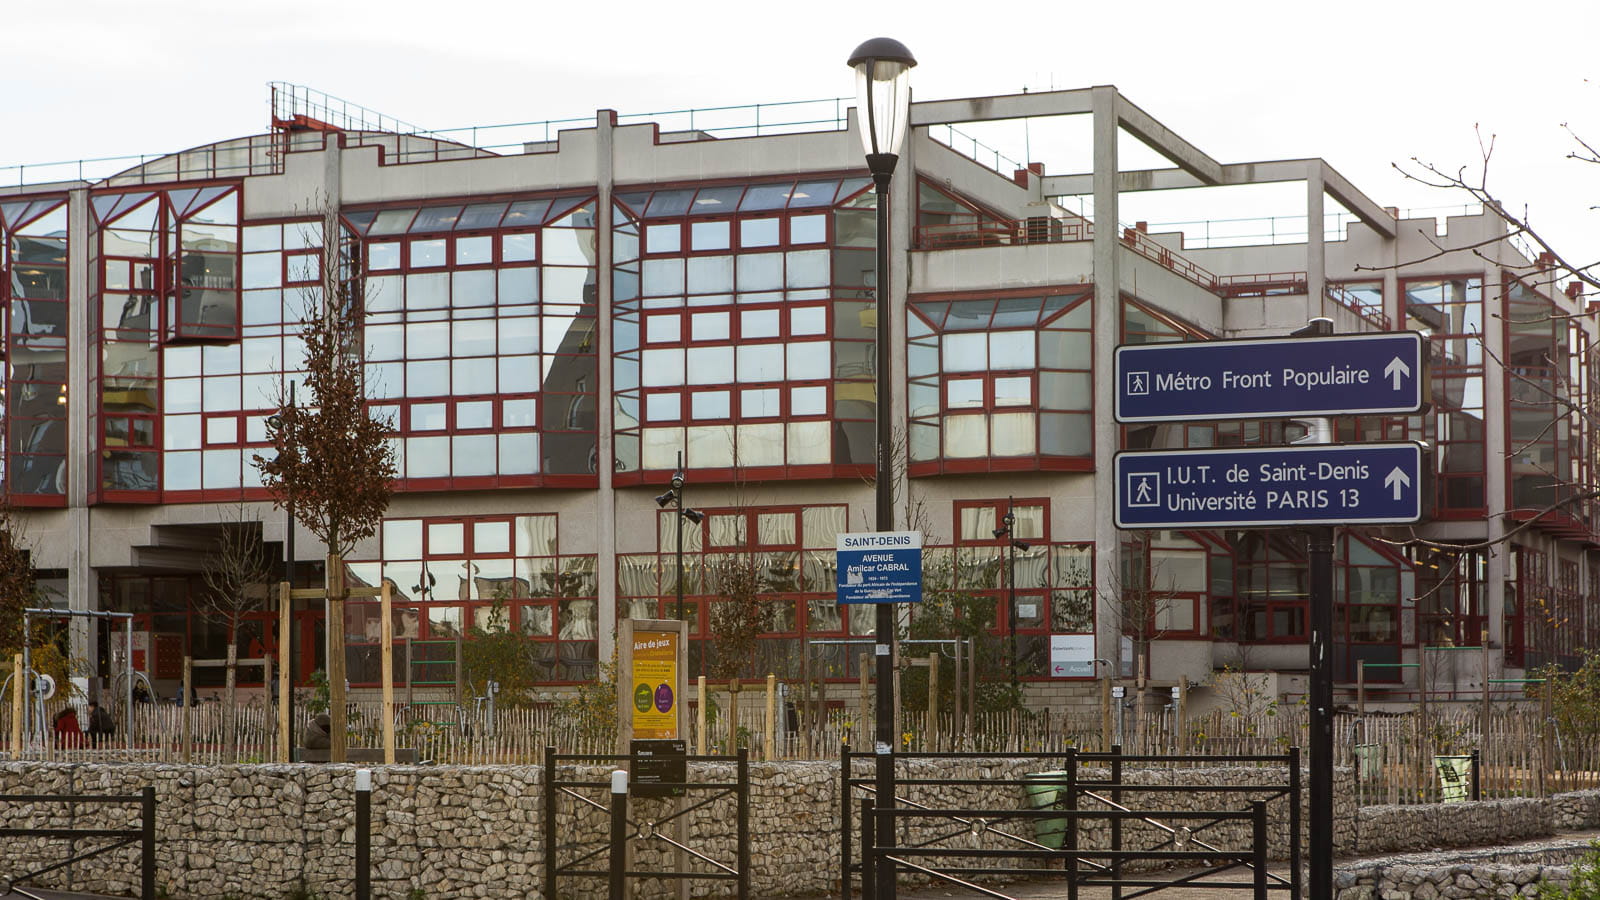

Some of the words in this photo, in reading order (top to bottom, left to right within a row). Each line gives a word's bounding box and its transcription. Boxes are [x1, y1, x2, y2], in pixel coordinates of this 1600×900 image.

[1156, 371, 1211, 391] Métro
[1223, 369, 1271, 388] Front
[1283, 365, 1370, 391] Populaire
[1167, 466, 1216, 484] I.U.T.
[1226, 464, 1250, 483] de
[1260, 461, 1370, 482] Saint-Denis
[1167, 490, 1256, 511] Université
[1266, 490, 1329, 509] PARIS
[1339, 489, 1360, 508] 13
[845, 536, 911, 547] SAINT-DENIS
[863, 554, 894, 562] AVENUE
[877, 564, 909, 572] CABRAL
[634, 641, 647, 650] Aire
[648, 640, 655, 649] de
[656, 639, 670, 649] jeux
